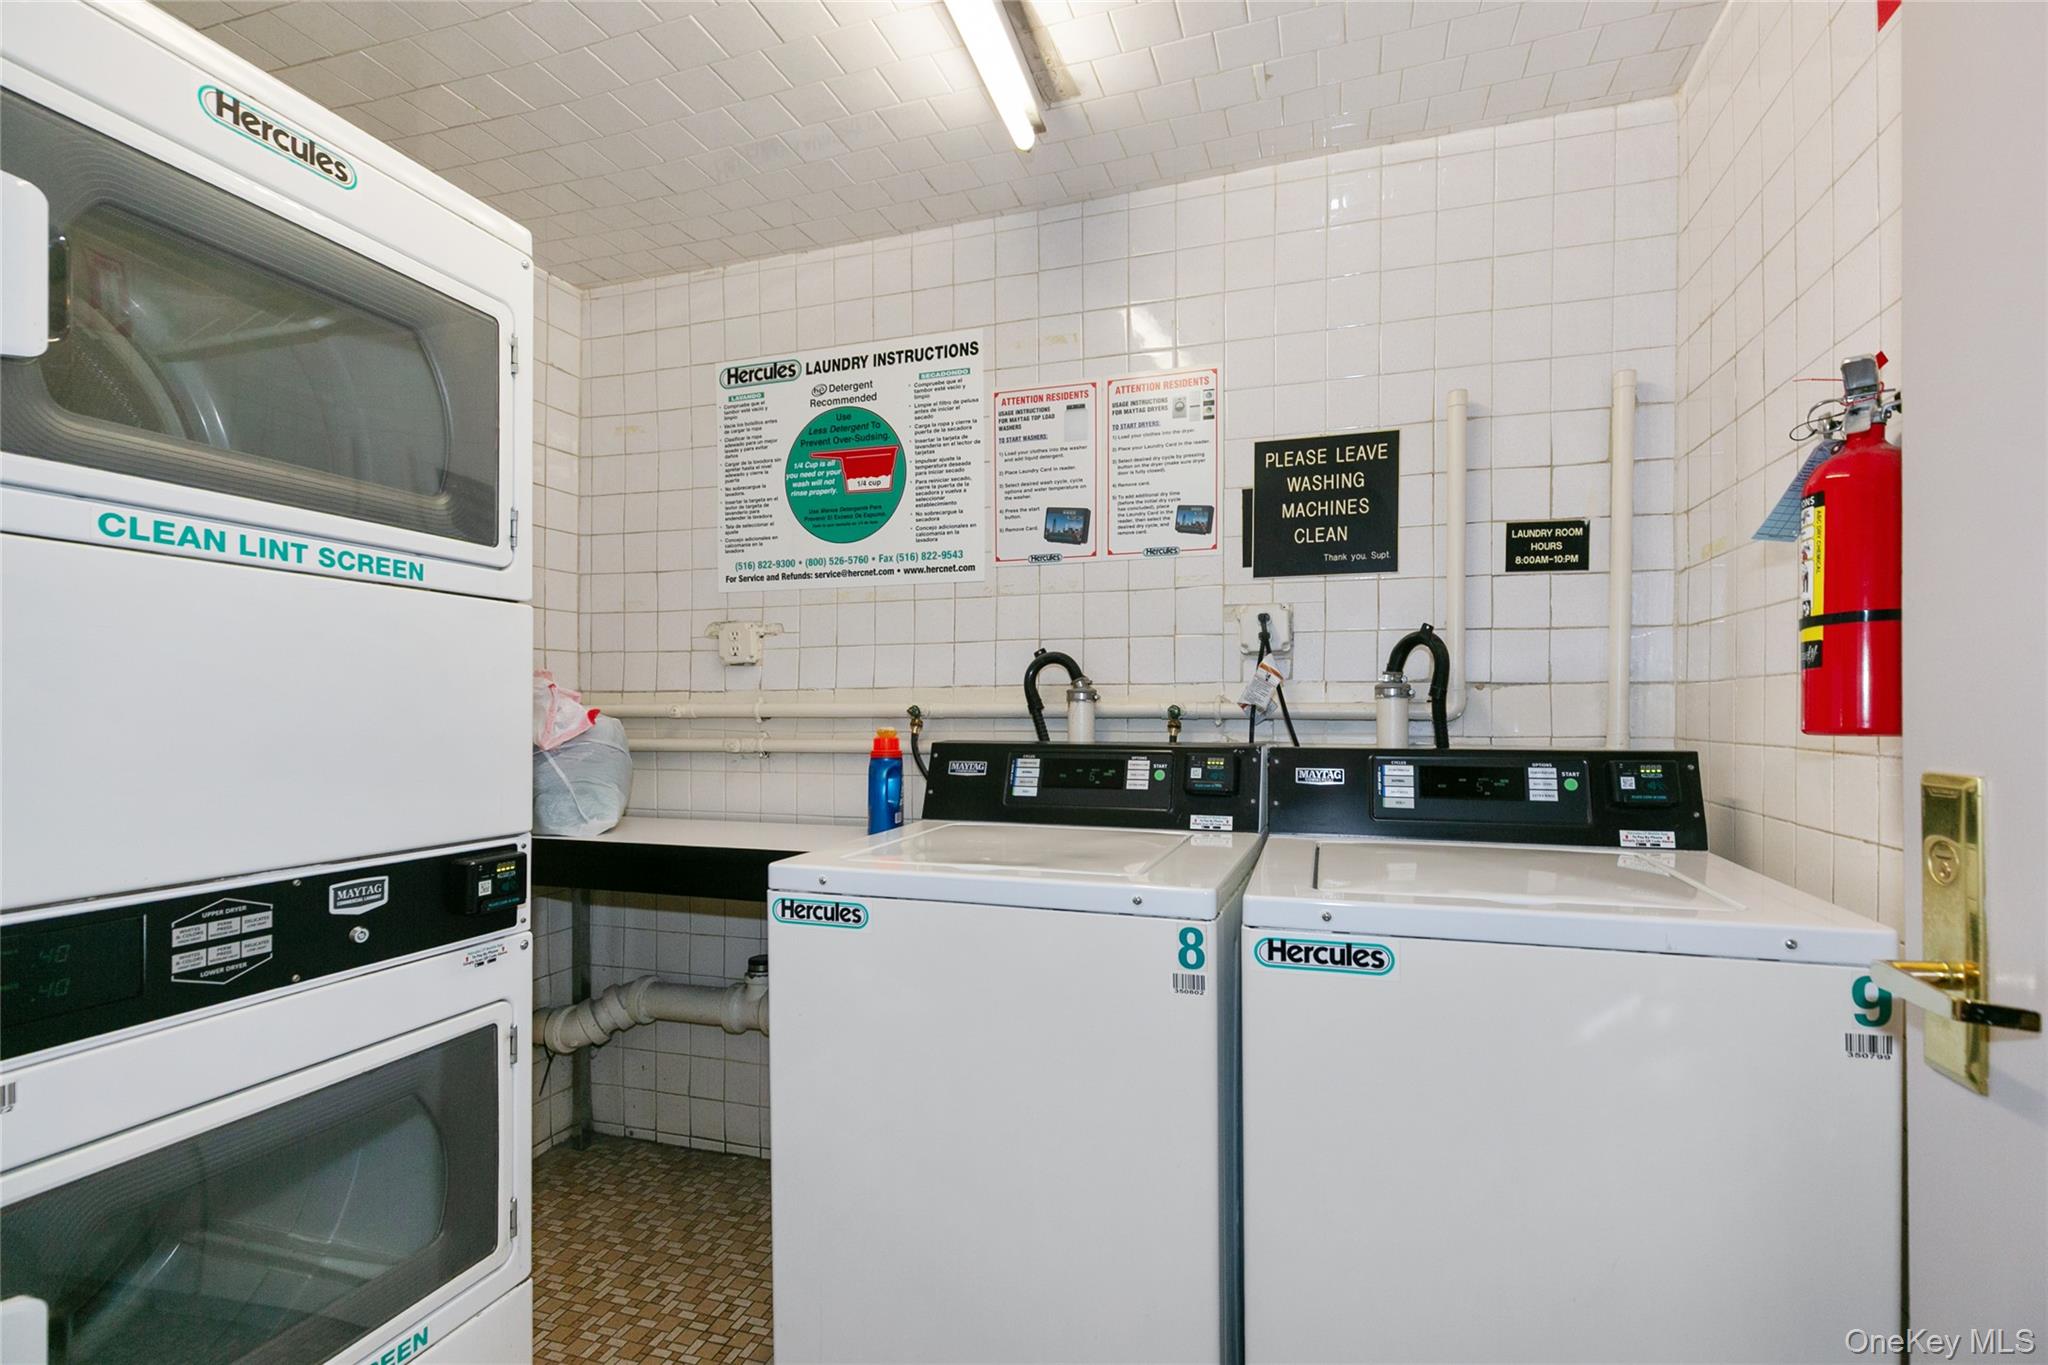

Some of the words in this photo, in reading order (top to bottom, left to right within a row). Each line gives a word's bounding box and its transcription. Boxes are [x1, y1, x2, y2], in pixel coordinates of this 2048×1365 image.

[216, 89, 348, 182] Hercules
[727, 363, 796, 385] Hercules
[805, 355, 869, 375] LAUNDRY
[873, 341, 980, 367] INSTRUCTIONS
[829, 381, 873, 393] Detergent
[1115, 382, 1160, 395] ATTENTION
[1163, 376, 1210, 389] RESIDENTS
[810, 392, 877, 407] Recommended
[1001, 394, 1044, 407] ATTENTION
[1046, 389, 1089, 402] RESIDENTS
[1130, 397, 1168, 406] INSTRUCTIONS
[836, 413, 852, 421] Use
[1015, 407, 1050, 415] INSTRUCTIONS
[1123, 407, 1146, 415] MAYTAG
[1147, 405, 1168, 413] DRYERS
[1009, 415, 1030, 423] MAYTAG
[809, 426, 827, 435] Less
[829, 422, 869, 434] Detergent
[871, 421, 881, 430] To
[800, 437, 831, 448] Prevent
[1265, 448, 1327, 468] PLEASE
[1336, 443, 1388, 463] LEAVE
[805, 460, 818, 469] Cup
[1287, 472, 1364, 492] WASHING
[1282, 498, 1370, 518] MACHINES
[1294, 526, 1348, 544] CLEAN
[1512, 528, 1552, 538] LAUNDRY
[1555, 528, 1583, 537] ROOM
[97, 512, 226, 552] CLEAN
[239, 534, 308, 564] LINT
[318, 546, 424, 582] SCREEN
[1145, 547, 1177, 556] Hercules
[1530, 542, 1563, 551] HOURS
[735, 561, 756, 572] (516)
[758, 559, 796, 570] 822-9300
[805, 557, 827, 568] (800)
[829, 555, 869, 566] 526-5760
[879, 554, 894, 563] Fax
[896, 552, 919, 564] (516)
[921, 550, 964, 561] 822-9543
[1030, 554, 1060, 563] Hercules
[738, 574, 765, 582] Service
[781, 572, 813, 580] Refunds:
[814, 568, 895, 578] service@hercnet.com
[904, 565, 976, 574] www.hercnet.com
[951, 762, 984, 770] MAYTAG
[1298, 769, 1342, 779] MAYTAG
[336, 884, 382, 900] MAYTAG
[202, 909, 224, 918] UPPER
[225, 905, 247, 914] DRYER
[781, 899, 862, 924] Hercules
[1178, 927, 1205, 970] 8
[1267, 938, 1385, 968] Hercules
[200, 968, 224, 978] LOWER
[226, 962, 247, 972] DRYER
[1852, 976, 1892, 1027] 9
[370, 1326, 428, 1365] EEN
